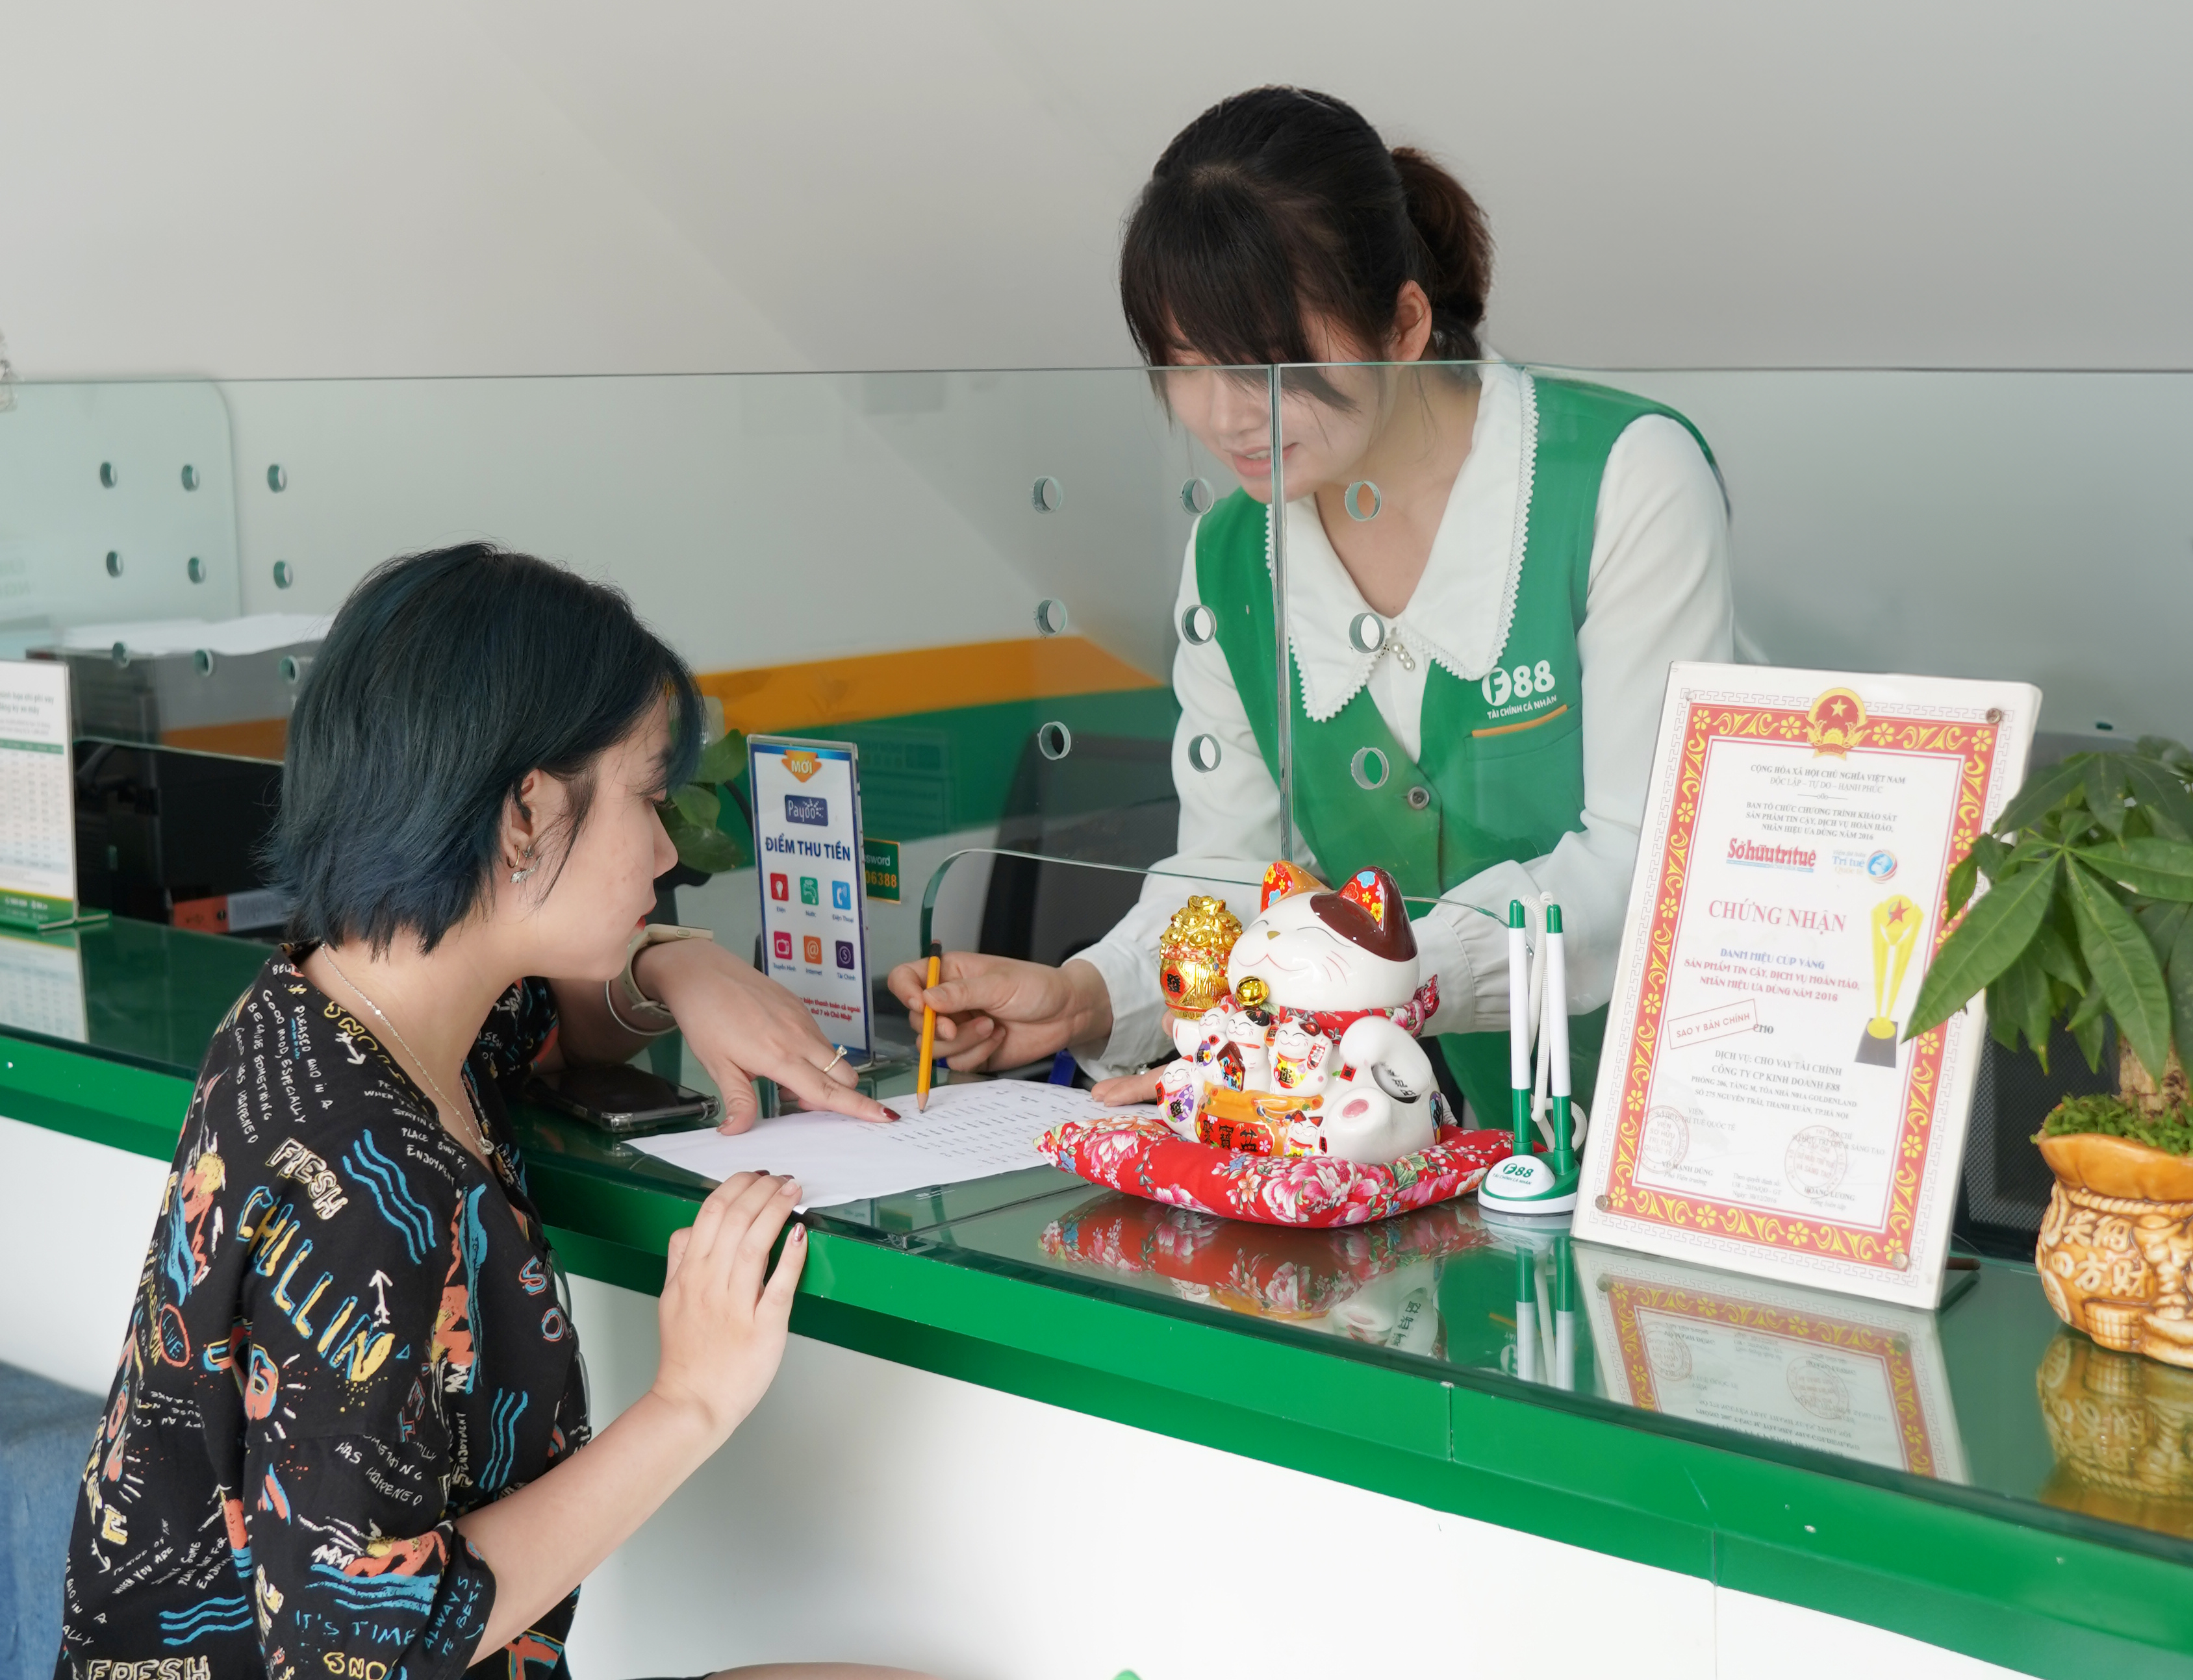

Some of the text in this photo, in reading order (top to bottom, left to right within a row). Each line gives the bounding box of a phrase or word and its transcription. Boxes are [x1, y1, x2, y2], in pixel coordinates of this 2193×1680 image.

[1482, 660, 1555, 707] F88
[1487, 694, 1556, 720] TÀI CHÍNH CÁ NHÂN
[791, 760, 812, 774] MỚI
[1751, 764, 1906, 785] CỘNG HÒA XÃ HỘI CHỦ NGHĨA VIỆT NAM
[1770, 777, 1786, 786] ĐỘC
[1787, 777, 1801, 787] LẬP
[1808, 779, 1819, 789] TỰ
[1838, 783, 1860, 792] HẠNH
[1862, 783, 1883, 794] PHÚC
[788, 799, 816, 822] Payoo
[1763, 802, 1773, 810] TỔ
[1775, 803, 1795, 812] CHỨC
[1798, 805, 1830, 816] CHƯƠNG
[1832, 808, 1855, 818] TRÌNH
[1858, 810, 1880, 820] KHẢO
[1882, 813, 1897, 821] SÁT
[1799, 816, 1816, 825] CẬY,
[1818, 818, 1836, 827] DỊCH
[1839, 820, 1849, 829] VỤ
[1851, 820, 1872, 829] HOÀN
[1762, 823, 1782, 832] NHÃN
[1784, 824, 1802, 834] HIỆU
[1805, 826, 1815, 834] ƯA
[1816, 828, 1837, 836] DÙNG
[1840, 830, 1856, 838] NĂM
[765, 833, 850, 861] ĐIỂM THU TIỀN
[865, 855, 890, 866] sword
[1708, 899, 1846, 934] CHỨNG NHẬN
[1721, 948, 1824, 970] DANH HIỆU CÚP VÀNG
[1684, 959, 1701, 968] SẢN
[1704, 960, 1730, 973] PHẨM
[1733, 965, 1747, 975] TIN
[1750, 967, 1768, 979] CẬY,
[1770, 970, 1793, 982] DỊCH
[1796, 973, 1807, 983] VỤ
[1810, 973, 1835, 986] HOÀN
[1700, 975, 1838, 1001] NHÃN HIỆU ƯA DÙNG NĂM 2016
[1677, 1027, 1693, 1038] SAO
[1703, 1020, 1719, 1031] BẢN
[1723, 1012, 1750, 1025] CHÍNH
[235, 1027, 245, 1057] GOOD
[247, 1002, 272, 1121] BECAUSE SOMETHING
[263, 989, 306, 1123] GOOD MOOD, ESPECIALLY
[294, 1005, 333, 1110] PLEASED AND IN A
[1715, 1050, 1842, 1076] DỊCH VỤ: CHO VAY TÀI CHÍNH
[1712, 1064, 1840, 1092] CÔNG TY CP KINH DOANH F88
[364, 1090, 394, 1100] WHEN
[1692, 1075, 1714, 1085] PHÒNG
[1730, 1081, 1748, 1090] TẦNG
[1760, 1085, 1773, 1095] TÒA
[1775, 1088, 1789, 1097] NHÀ
[1808, 1093, 1857, 1108] GOLDENLAND
[1717, 1091, 1744, 1103] NGUYỄN
[1766, 1100, 1790, 1110] THANH
[1792, 1104, 1812, 1114] XUÂN,
[392, 1108, 435, 1131] STAYING
[401, 1127, 429, 1142] PLACE
[406, 1144, 455, 1186] ENJOYMENT
[1503, 1163, 1534, 1177] F88
[265, 1137, 348, 1220] FRESH
[236, 1185, 396, 1382] CHILLIN
[151, 1391, 183, 1403] MAKE
[171, 1407, 200, 1417] AUSE
[335, 1442, 423, 1507] HAS HAPPENED
[181, 1541, 201, 1563] SOME
[210, 1536, 227, 1555] FOR
[112, 1577, 135, 1594] WHEN
[133, 1564, 152, 1581] YOU
[155, 1546, 174, 1564] ARE
[71, 1599, 83, 1614] IN
[424, 1575, 468, 1649] ALWAYS
[456, 1579, 483, 1629] BEST
[62, 1624, 94, 1646] ALLY
[296, 1609, 416, 1646] IT'S TIME
[86, 1655, 211, 1680] FRESH
